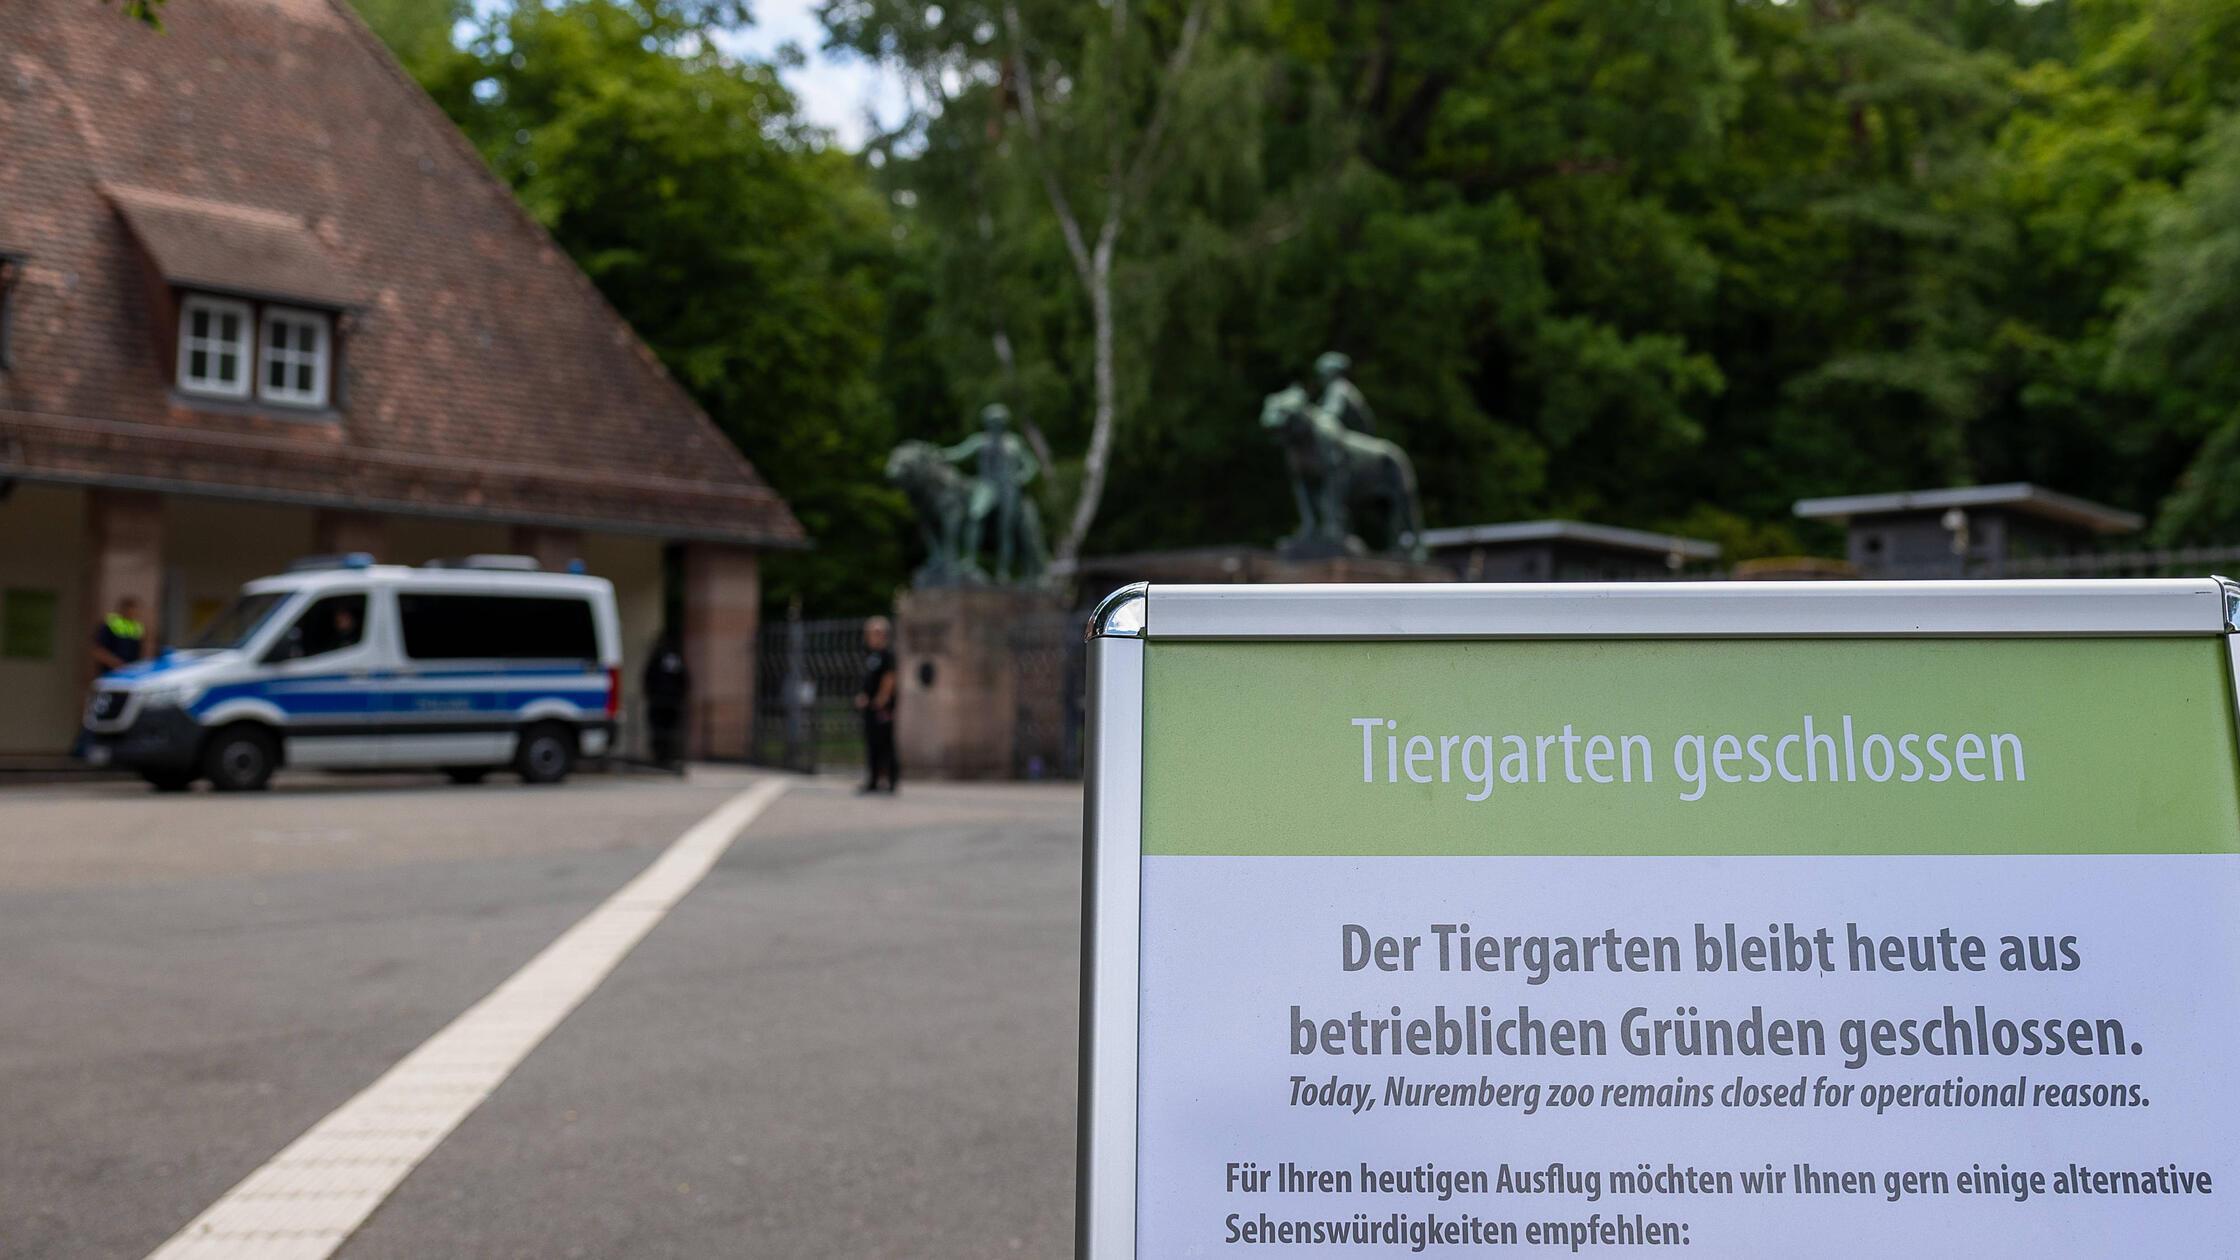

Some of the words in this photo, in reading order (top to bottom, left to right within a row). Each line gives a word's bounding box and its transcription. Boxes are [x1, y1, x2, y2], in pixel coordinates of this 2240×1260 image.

[1351, 716, 1654, 802] Tiergarten
[1674, 713, 2027, 802] geschlossen
[1343, 924, 1421, 971] Der
[1431, 923, 1681, 986] Tiergarten
[1695, 923, 1835, 973] bleibt
[1847, 923, 1987, 972] heute
[1999, 935, 2081, 972] aus
[1290, 1006, 1607, 1056] betrieblichen
[1620, 1006, 1826, 1057] Gründen
[1839, 1005, 2143, 1070] geschlossen.
[1289, 1075, 1376, 1114] Today,
[1383, 1075, 1541, 1115] Nuremberg
[1545, 1084, 1595, 1107] zoo
[1600, 1076, 1715, 1108] remains
[1720, 1075, 1808, 1108] closed
[1812, 1075, 1856, 1107] for
[1860, 1075, 2027, 1115] operational
[2032, 1083, 2150, 1108] reasons.
[1226, 1162, 1272, 1193] Für
[1278, 1161, 1353, 1193] Ihren
[1360, 1162, 1489, 1202] heutigen
[1495, 1162, 1602, 1202] Ausflug
[1609, 1163, 1733, 1194] möchten
[1739, 1163, 1787, 1194] wir
[1793, 1163, 1877, 1194] Ihnen
[1883, 1171, 1950, 1203] gern
[1956, 1163, 2046, 1203] einige
[2053, 1163, 2213, 1195] alternative
[1225, 1212, 1518, 1253] Sehenswürdigkeiten
[1525, 1213, 1690, 1253] empfehlen:
